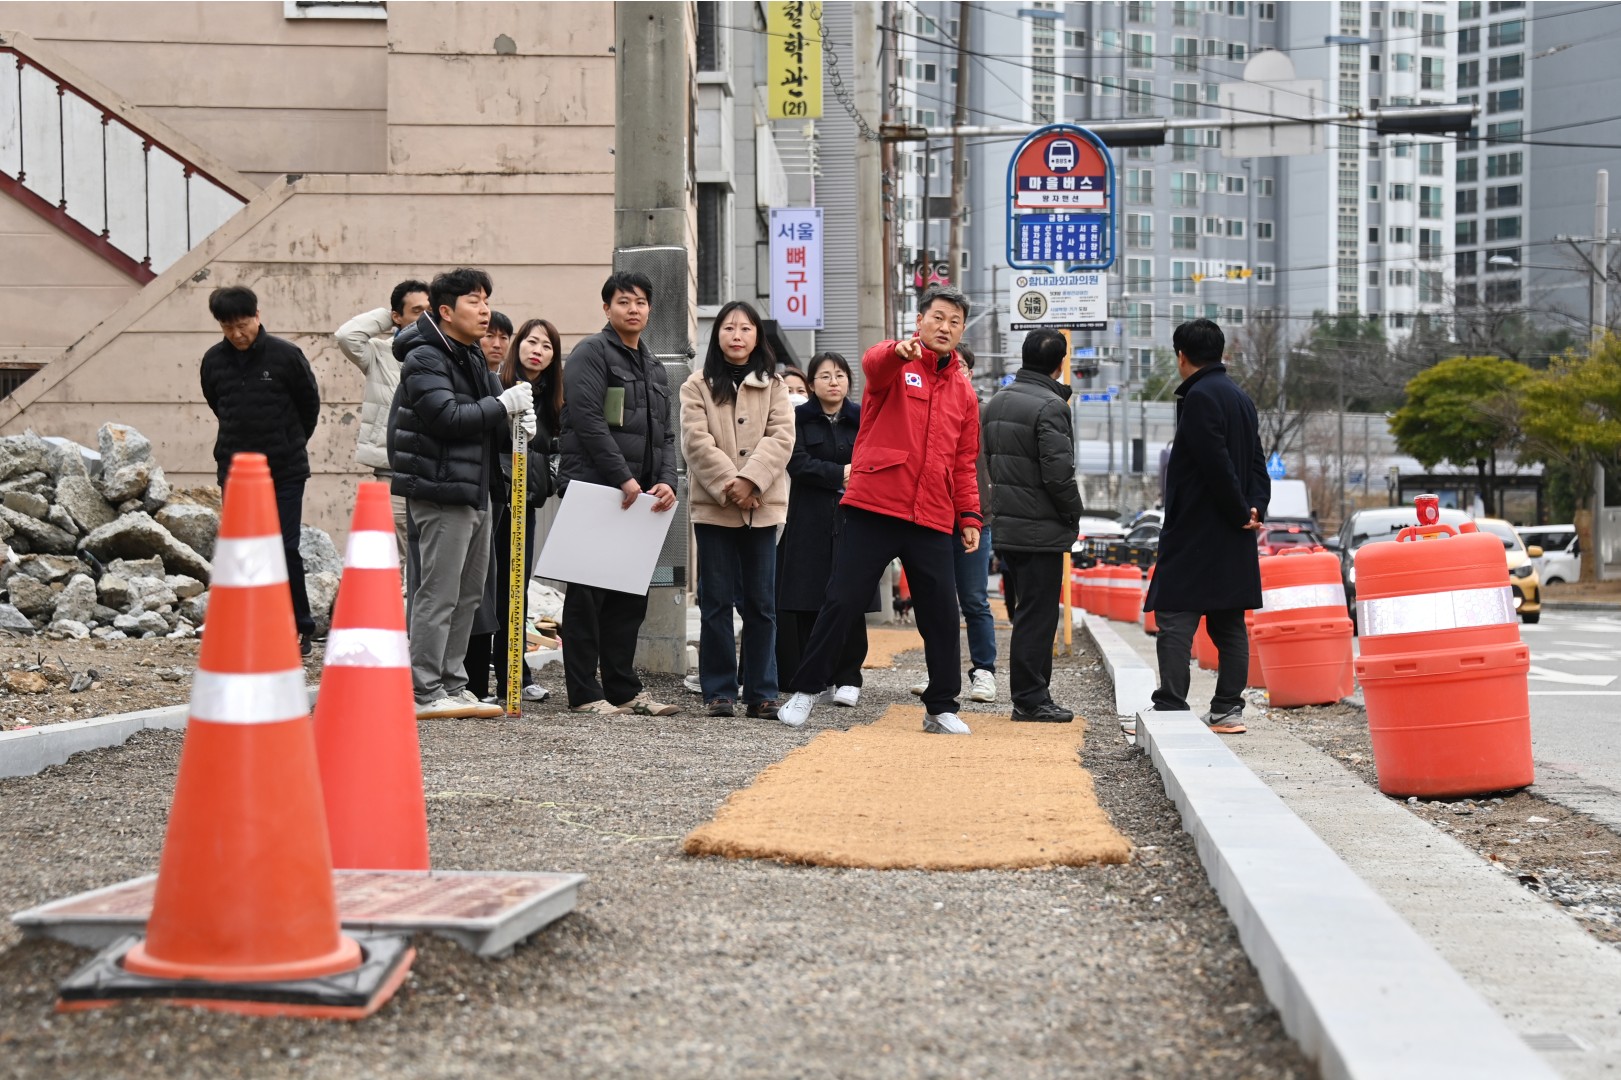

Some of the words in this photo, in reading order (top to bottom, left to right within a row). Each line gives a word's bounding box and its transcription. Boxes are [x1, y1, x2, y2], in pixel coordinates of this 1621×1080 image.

[1028, 176, 1093, 190] 마을버스
[778, 222, 814, 241] 서울
[785, 246, 807, 317] 뼈구이
[1024, 297, 1041, 305] 신축
[1024, 306, 1041, 314] 개원
